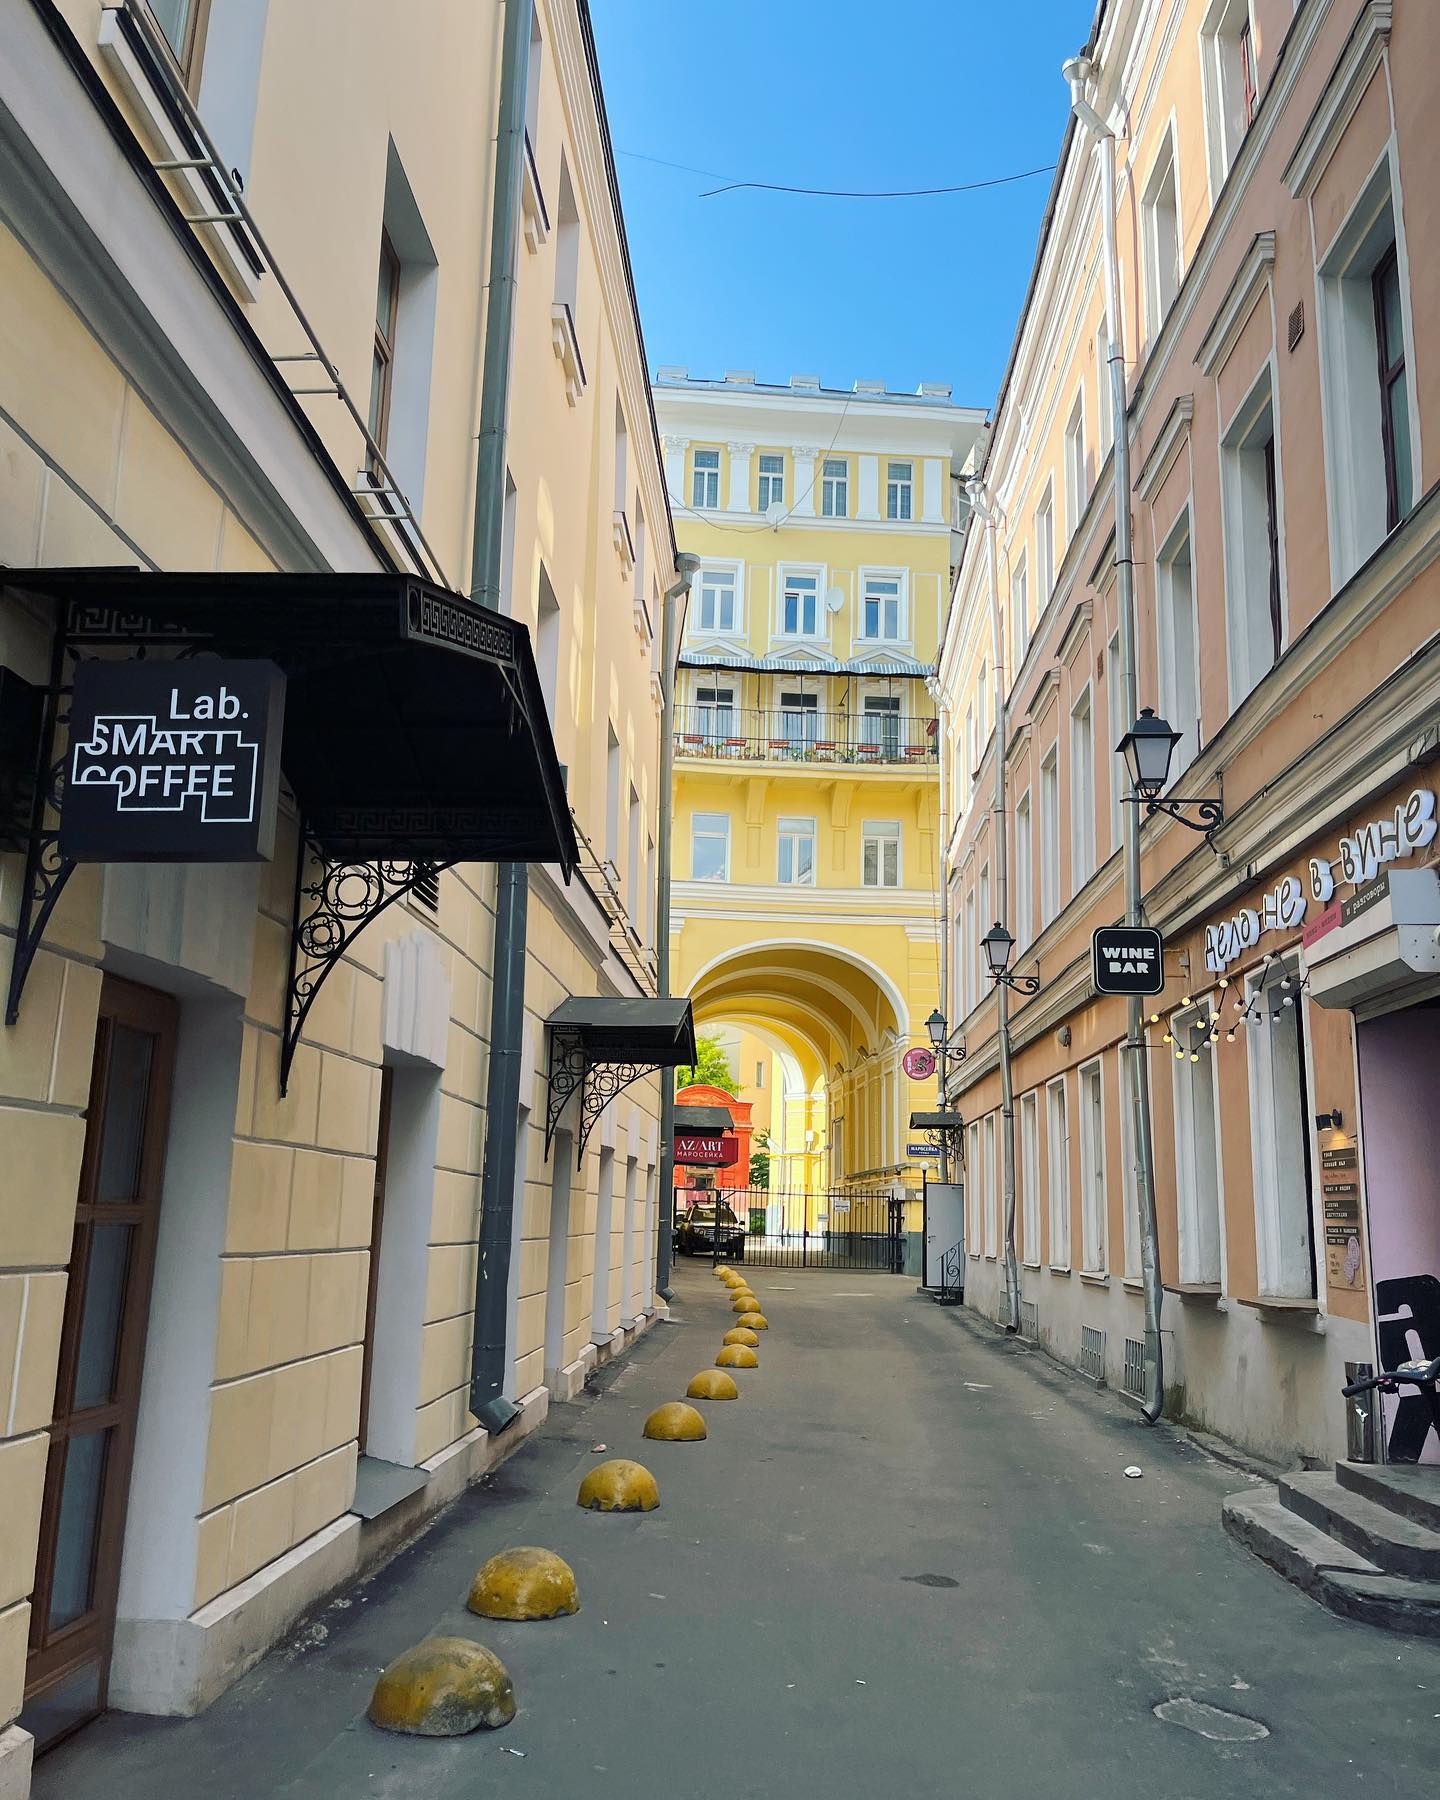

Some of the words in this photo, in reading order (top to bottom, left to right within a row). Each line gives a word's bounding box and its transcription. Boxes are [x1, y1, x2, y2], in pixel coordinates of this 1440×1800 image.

[169, 686, 249, 720] Lab.
[84, 723, 229, 756] SMART
[80, 765, 236, 798] COFFEE
[1262, 876, 1307, 930] не
[1309, 857, 1334, 902] в
[1339, 789, 1438, 884] вине
[1102, 947, 1155, 960] WINE
[1109, 962, 1149, 974] BAR
[676, 1151, 724, 1159] МАРОСЕЙКА
